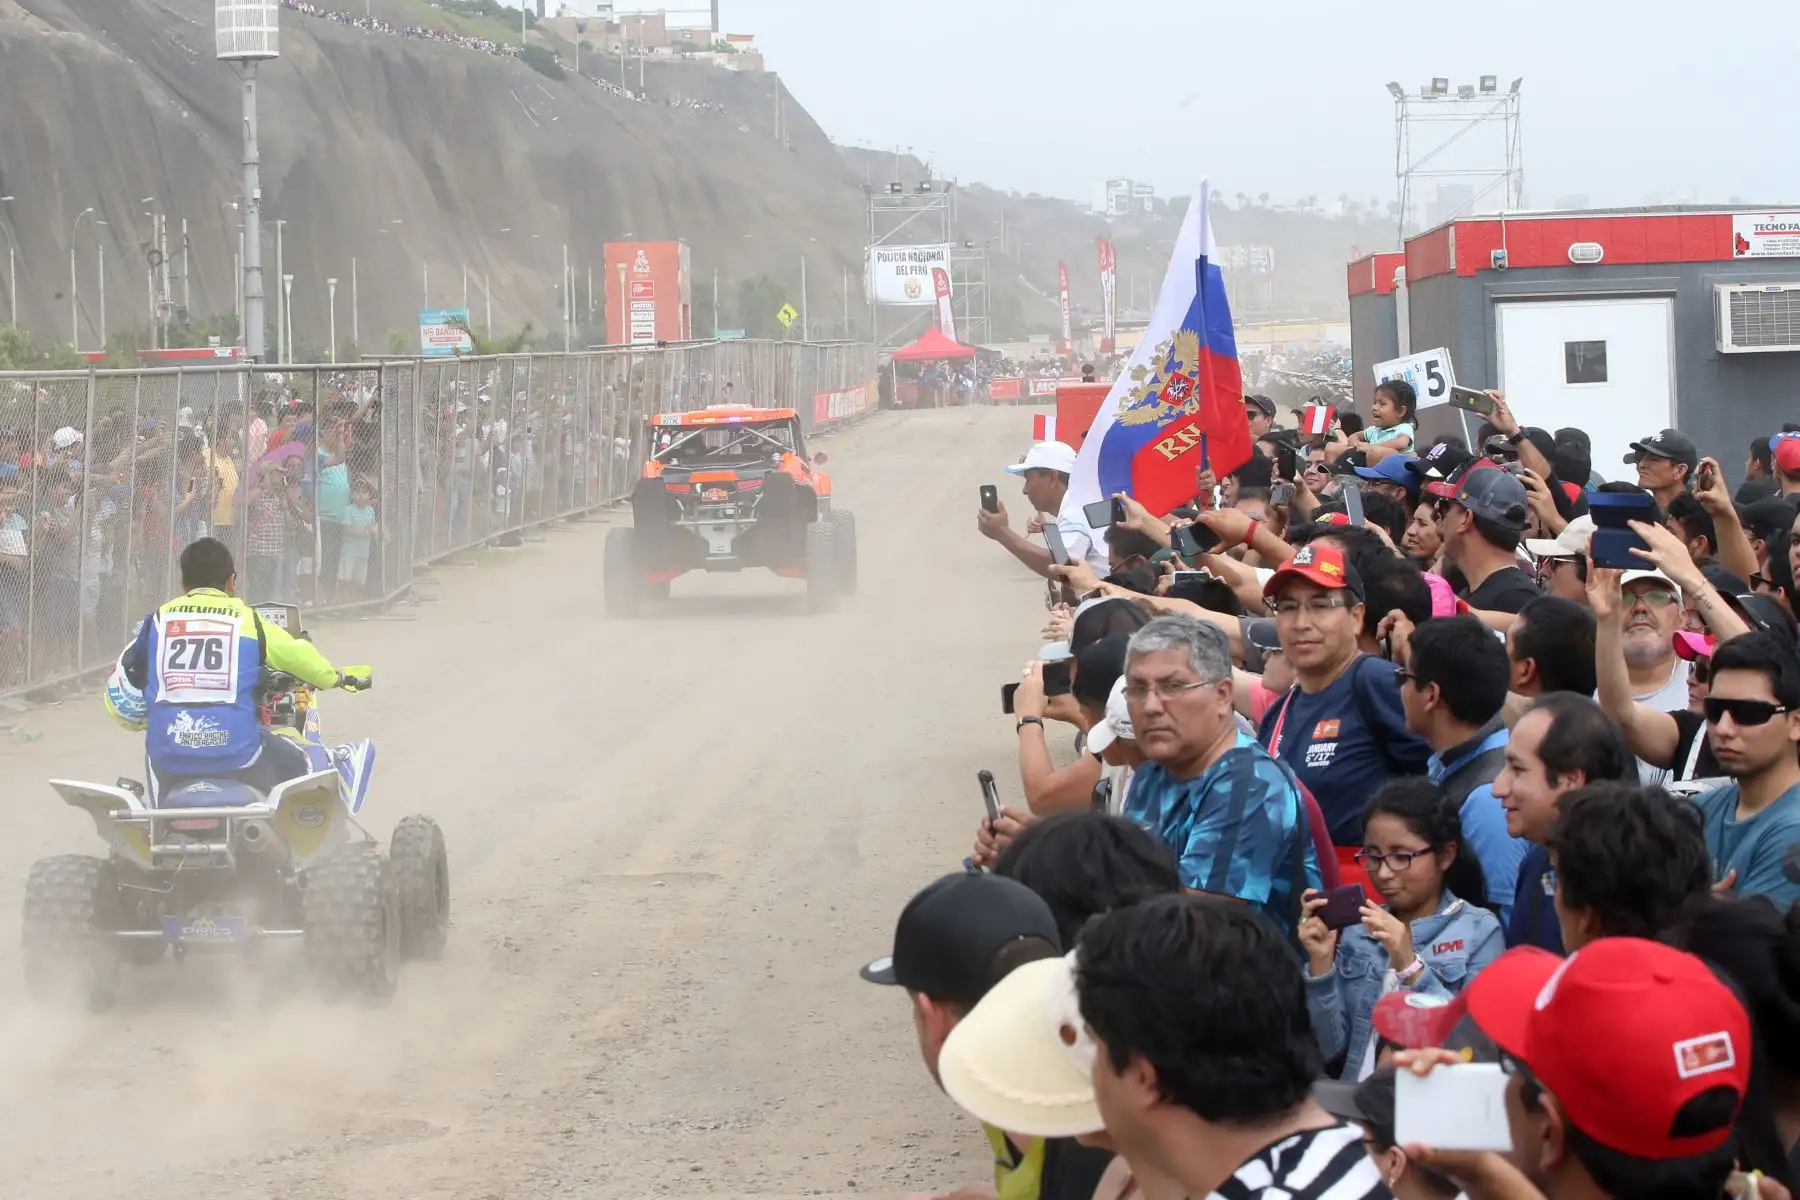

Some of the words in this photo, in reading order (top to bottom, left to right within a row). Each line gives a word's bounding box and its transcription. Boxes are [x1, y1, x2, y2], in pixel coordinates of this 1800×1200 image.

[1754, 223, 1786, 231] TECNO
[908, 250, 944, 262] NACIONAL
[896, 265, 908, 275] DEL
[1425, 359, 1446, 397] 5
[168, 637, 223, 670] 276
[1306, 742, 1338, 754] JANUARY
[1432, 939, 1464, 956] LOVE
